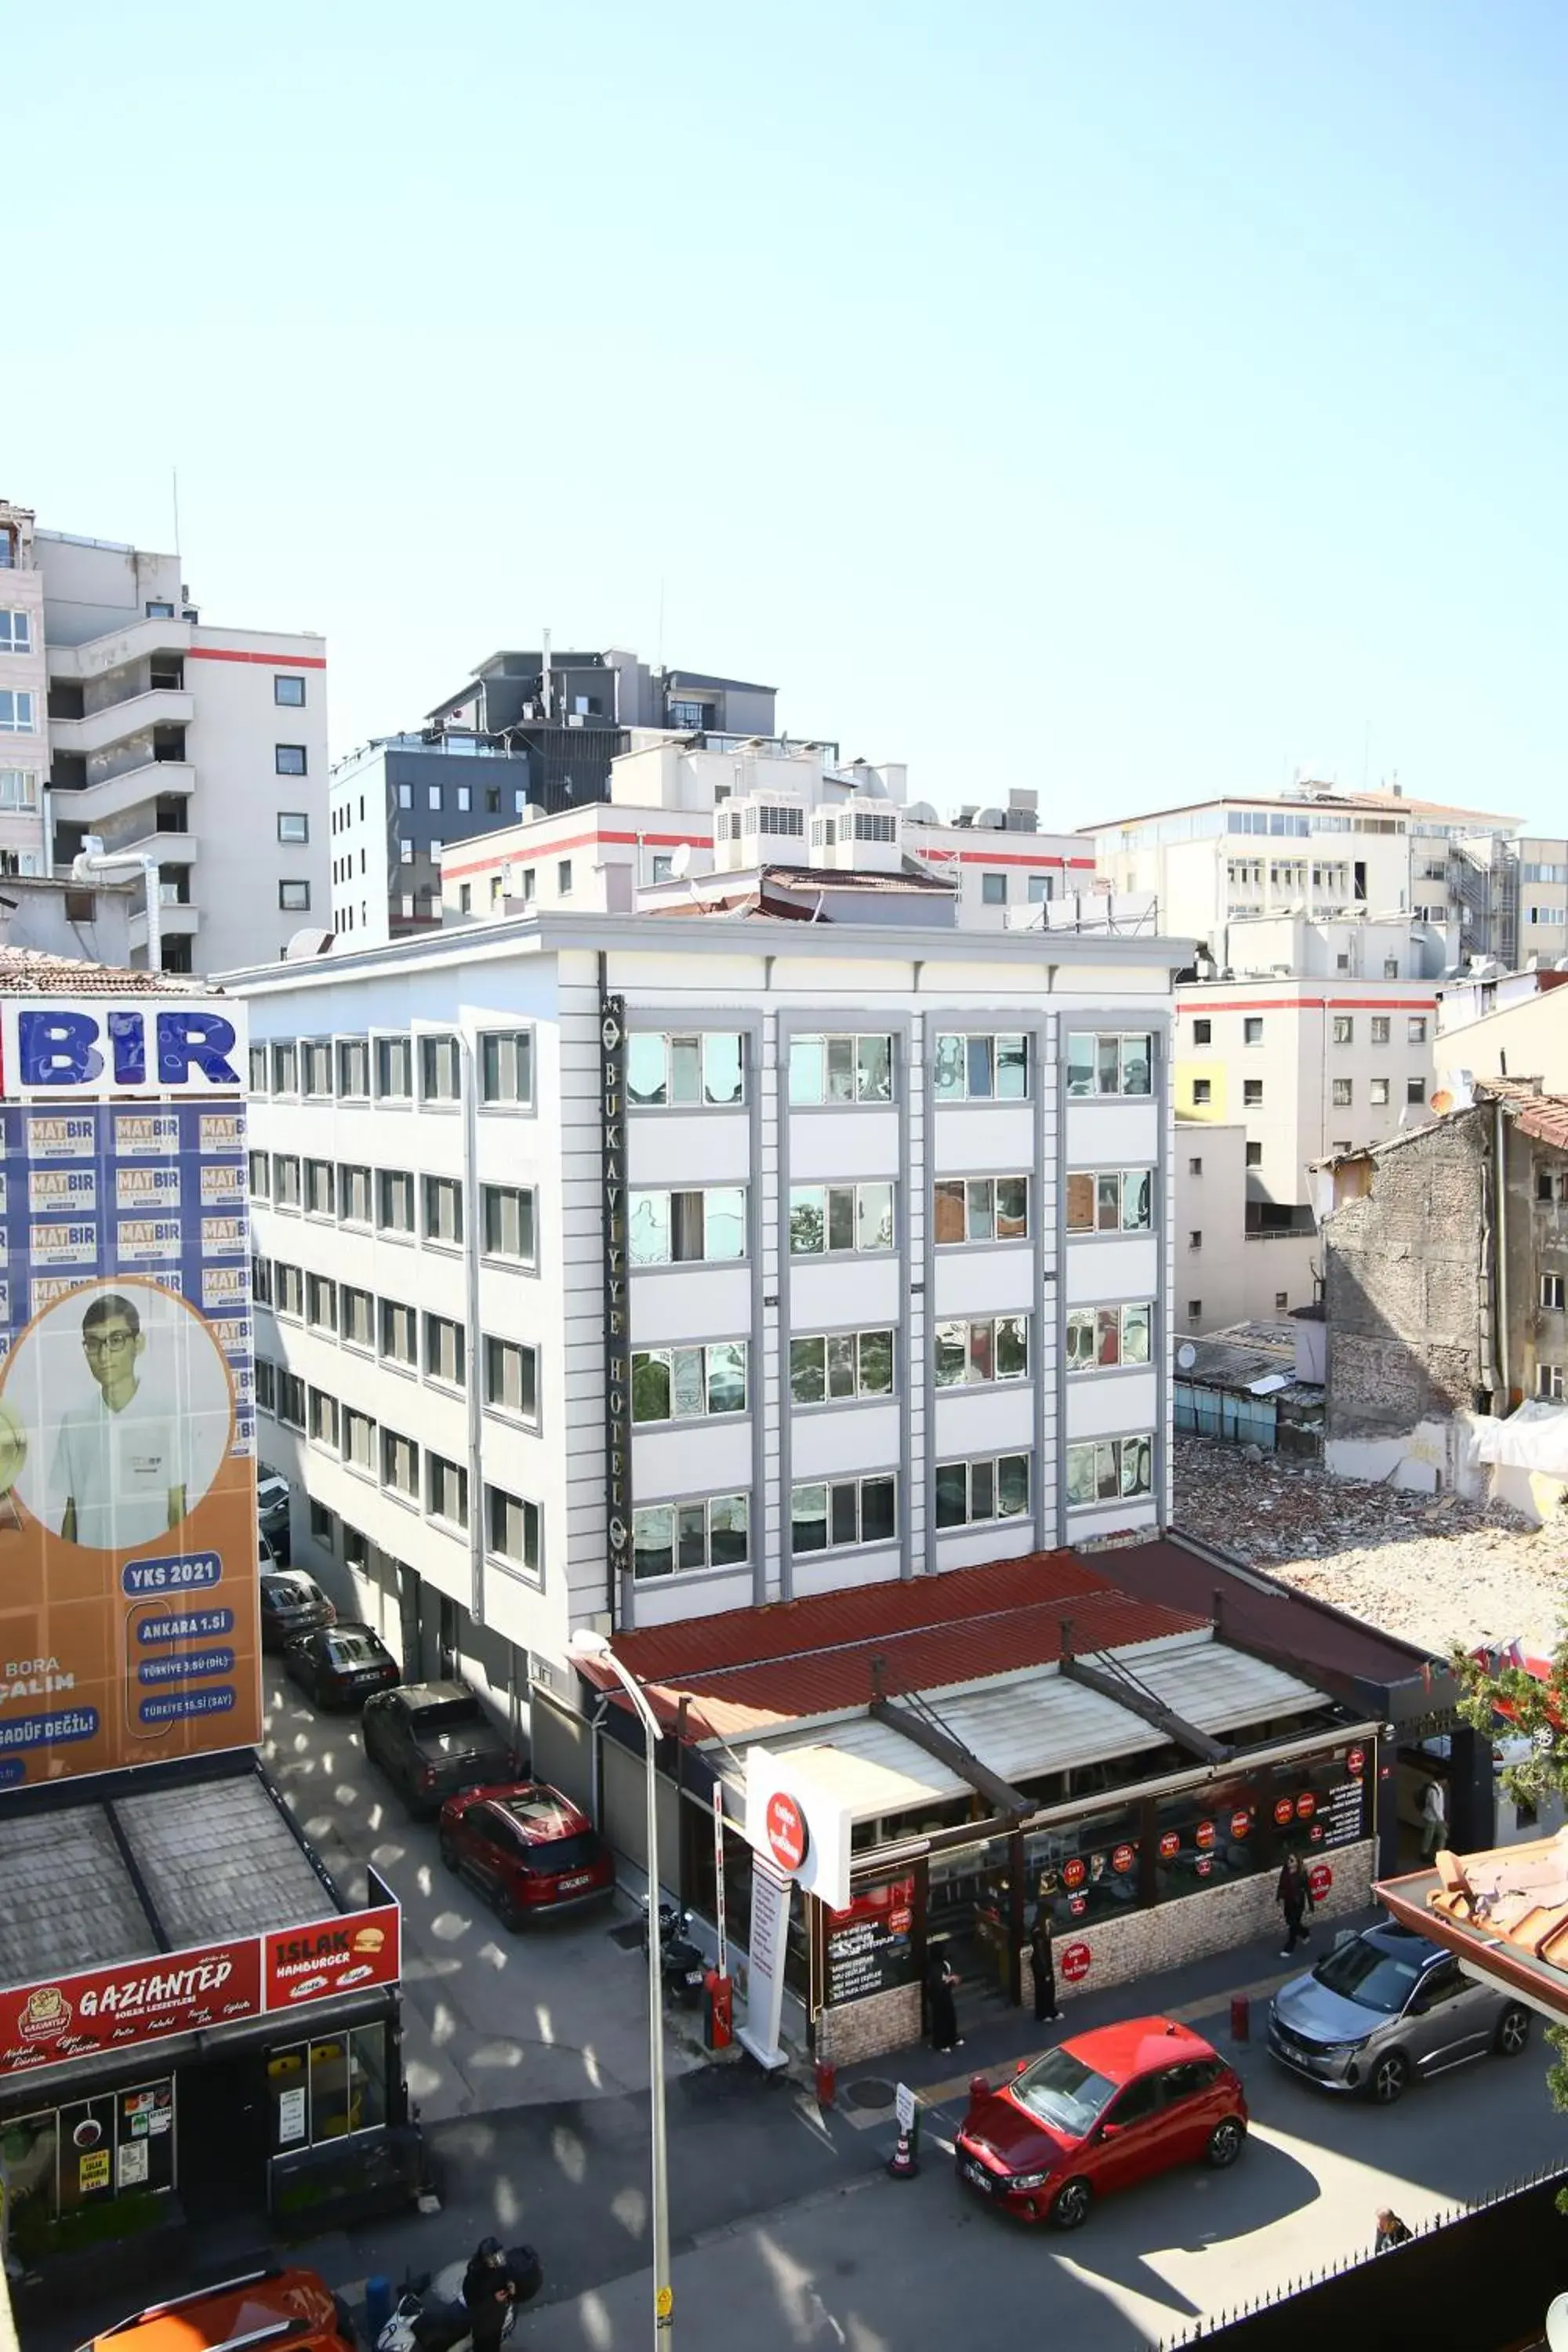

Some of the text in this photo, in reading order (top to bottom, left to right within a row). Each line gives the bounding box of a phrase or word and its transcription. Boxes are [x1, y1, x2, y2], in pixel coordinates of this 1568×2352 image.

[610, 1358, 623, 1507] HOTEL
[132, 1561, 213, 1588] YKS 2021
[143, 1619, 198, 1639] ANKARA
[5, 1657, 60, 1677] BORA
[45, 1713, 94, 1737] DEĞİL!
[276, 1930, 350, 1965] ISLAK
[277, 1951, 350, 1978] HAMBURGER
